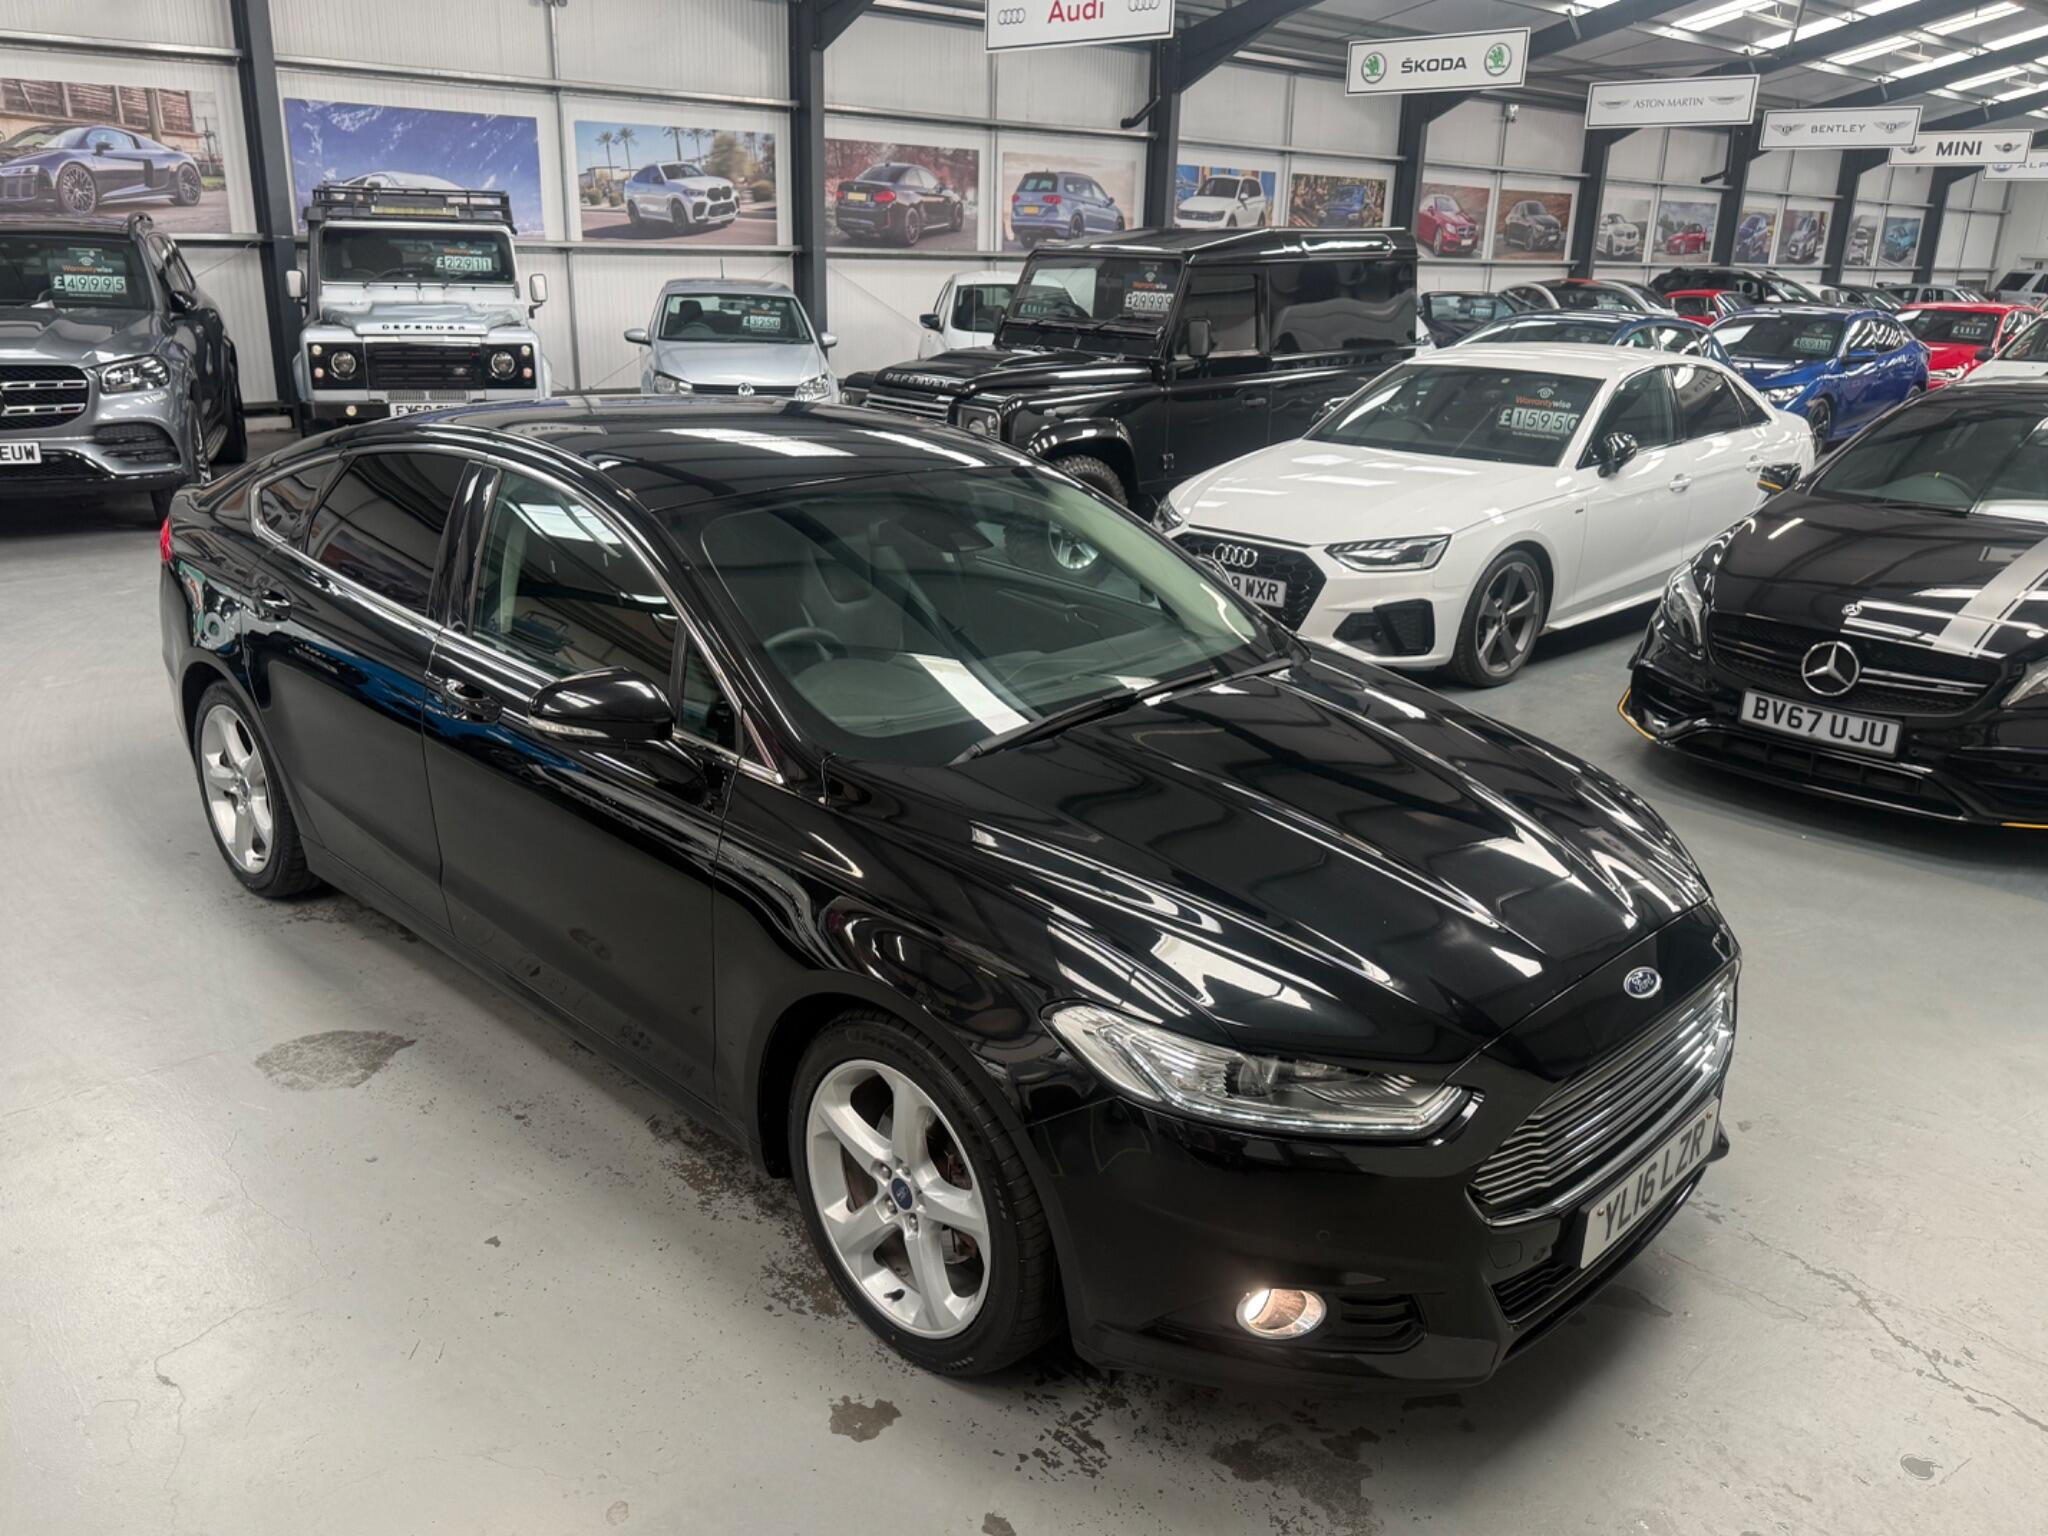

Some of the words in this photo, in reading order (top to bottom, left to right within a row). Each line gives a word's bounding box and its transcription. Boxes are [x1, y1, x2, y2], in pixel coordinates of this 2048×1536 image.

[1047, 0, 1104, 24] Audi
[1401, 56, 1467, 74] ŠKODA
[1633, 98, 1665, 109] ASTON
[1667, 97, 1704, 107] MARTIN
[1811, 123, 1866, 134] BENTLEY
[1935, 140, 1983, 156] MINI
[53, 275, 127, 292] £49995
[1515, 396, 1572, 409] Warrantywise
[1499, 408, 1578, 433] £15950
[0, 446, 35, 461] EUW
[1245, 578, 1279, 602] WXR
[1752, 696, 1823, 733] BV67
[1828, 714, 1888, 747] UJU
[1605, 1162, 1657, 1241] YL16
[1660, 1118, 1706, 1191] LZR
